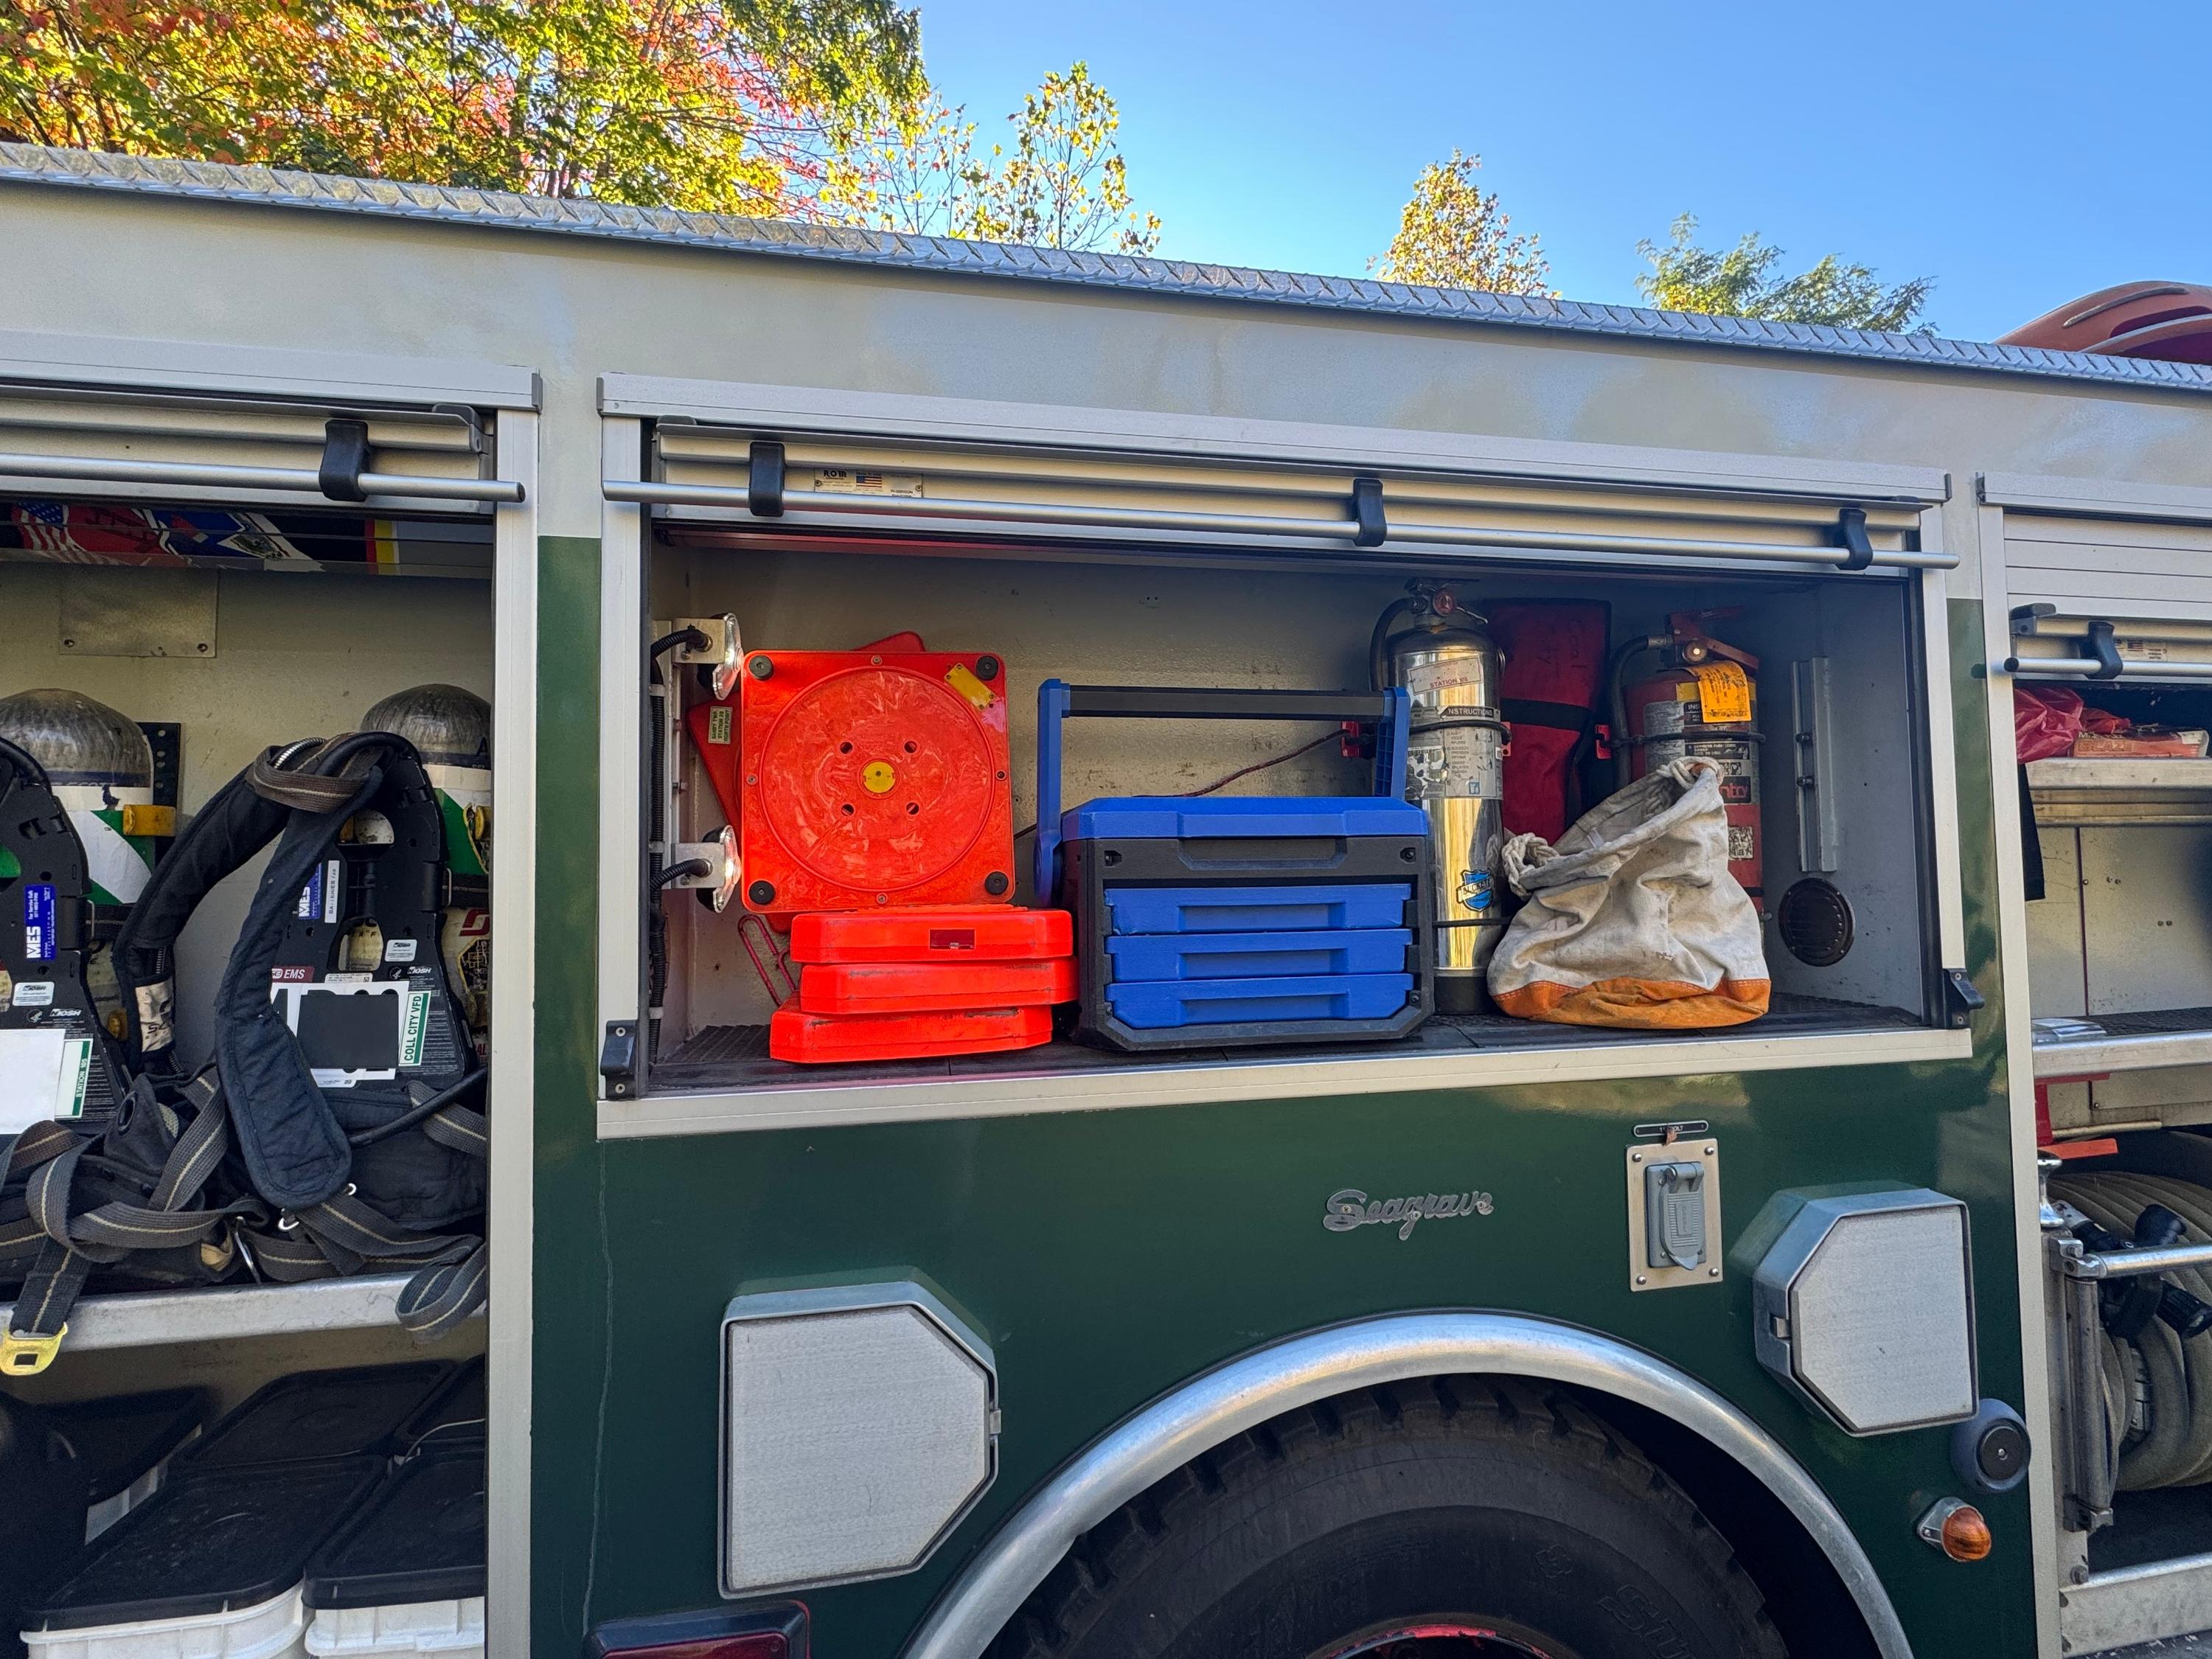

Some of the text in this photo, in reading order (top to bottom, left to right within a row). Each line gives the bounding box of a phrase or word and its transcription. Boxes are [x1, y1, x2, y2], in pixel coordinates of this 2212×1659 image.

[1430, 678, 1458, 689] STATION
[1447, 707, 1493, 717] NSTRUCTIONS
[26, 926, 41, 959] MES
[284, 969, 305, 979] EMS
[407, 966, 431, 974] NIOSH
[49, 1009, 82, 1017] NIOSH
[404, 995, 422, 1061] COLL CITY VFD
[75, 1071, 86, 1098] STATION
[1323, 1189, 1494, 1241] Seagrave
